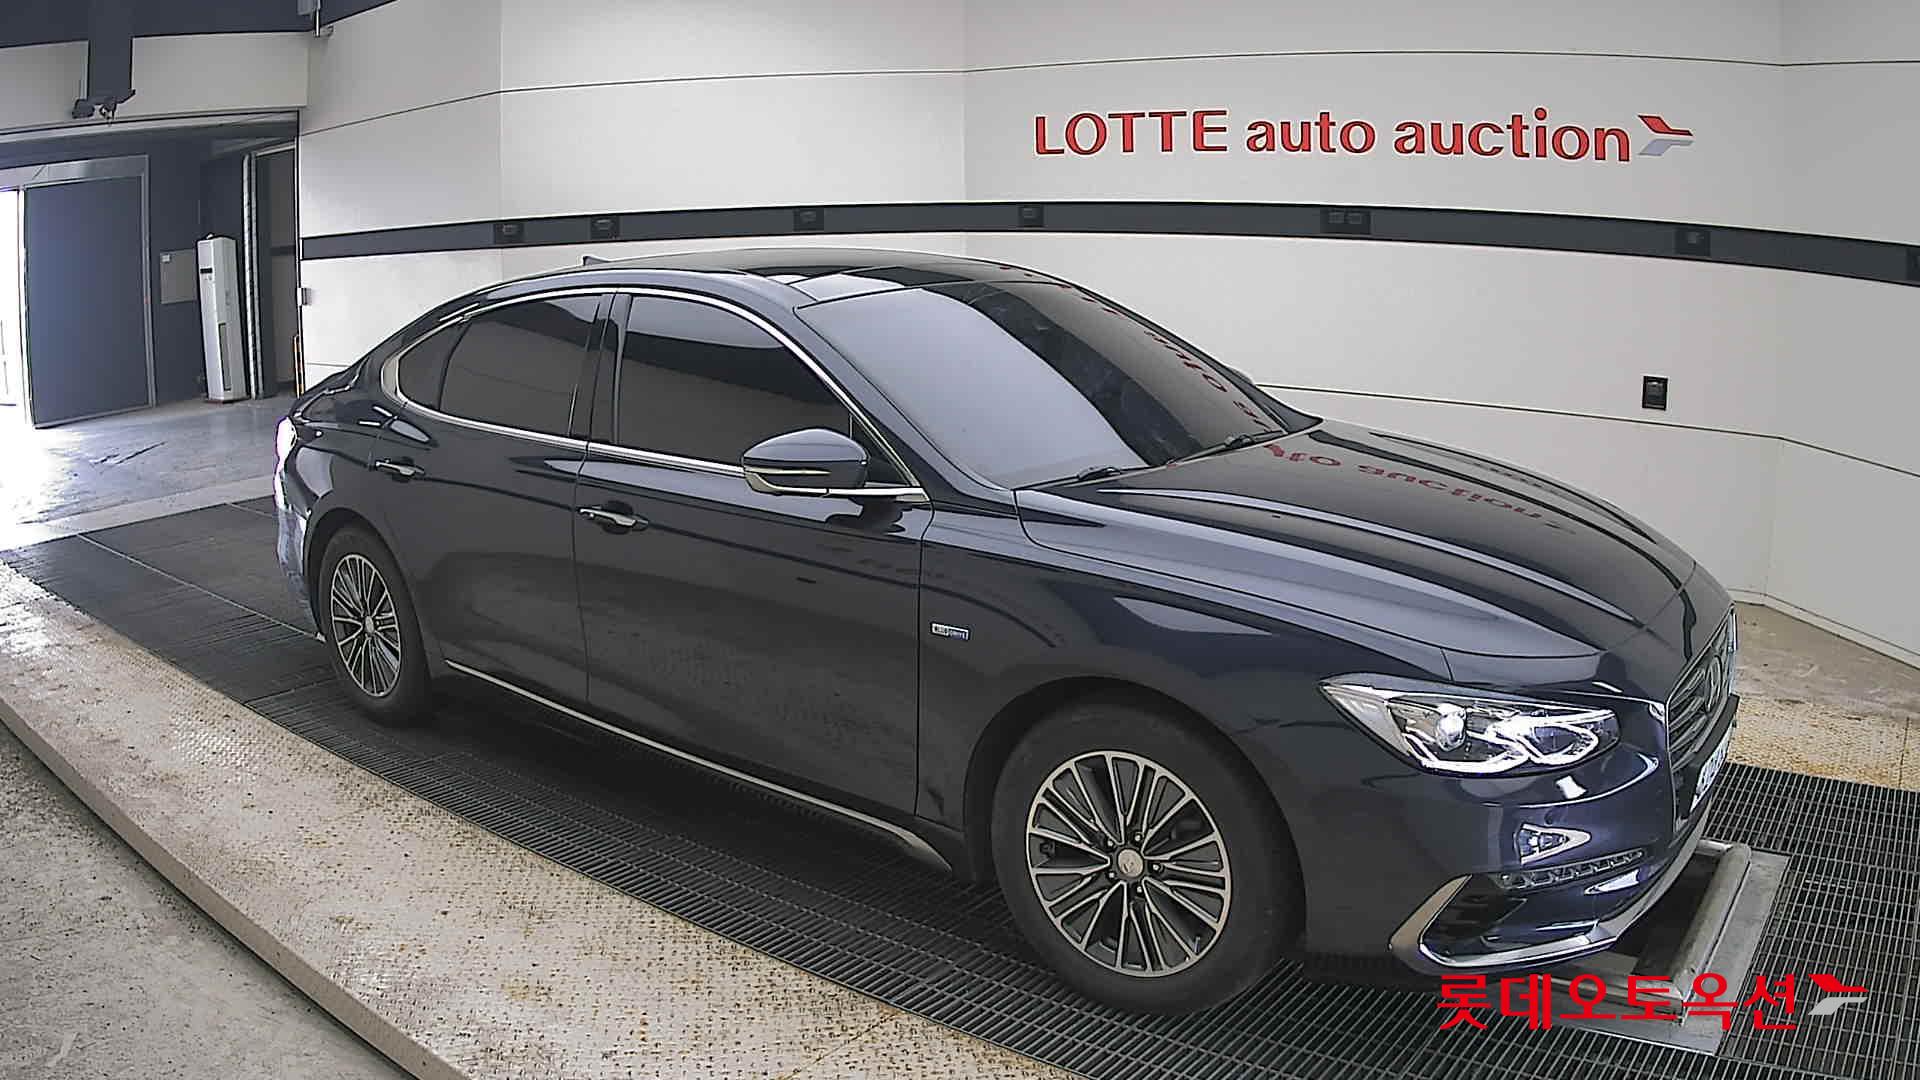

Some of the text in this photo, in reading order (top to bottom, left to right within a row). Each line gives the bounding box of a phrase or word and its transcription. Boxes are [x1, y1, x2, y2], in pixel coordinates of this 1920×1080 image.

[1034, 106, 1632, 163] LOTTE auto auction
